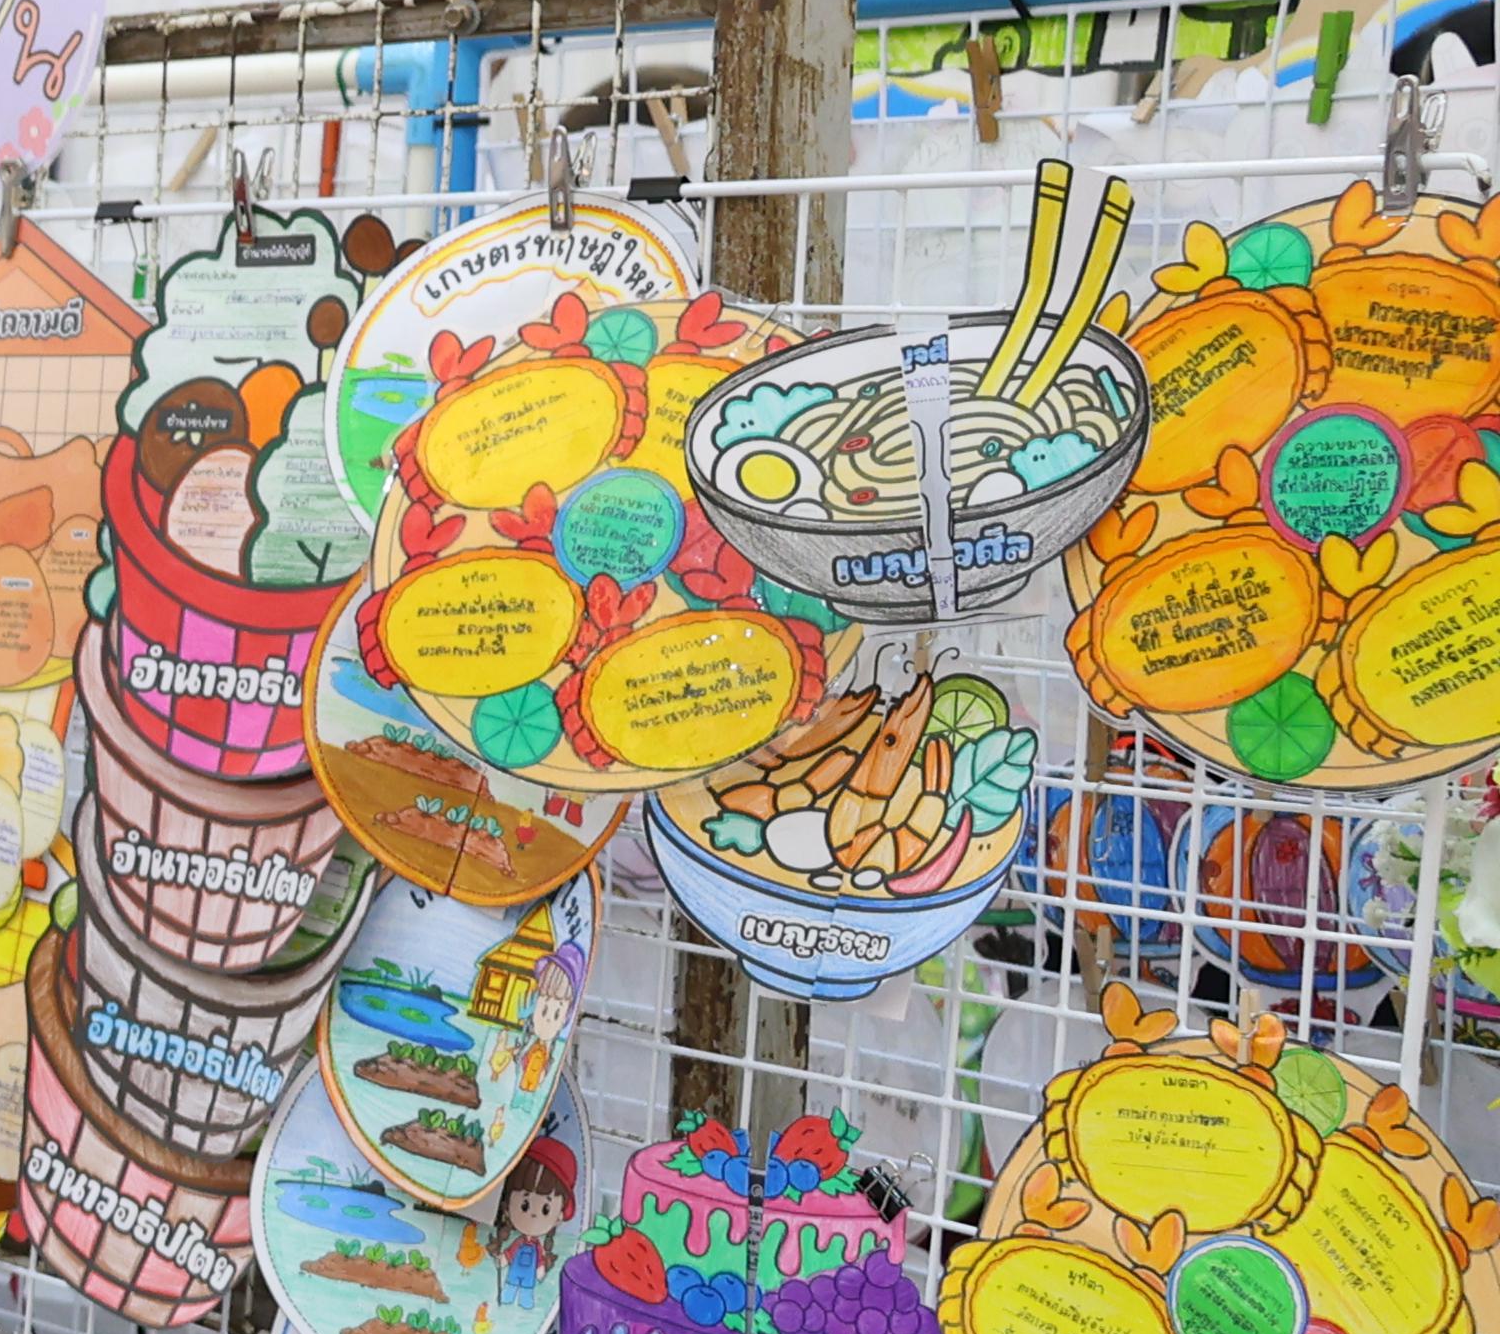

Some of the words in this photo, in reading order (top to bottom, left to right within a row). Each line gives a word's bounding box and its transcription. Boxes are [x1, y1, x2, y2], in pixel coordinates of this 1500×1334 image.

[112, 830, 316, 909] อำนาจอธิปไตย
[739, 914, 891, 964] เบญจธรรม
[86, 1003, 284, 1107] อำนาจอธิปไตย
[1162, 1076, 1209, 1091] เมตตา
[26, 1145, 237, 1294] อำนาจอธิปไตย
